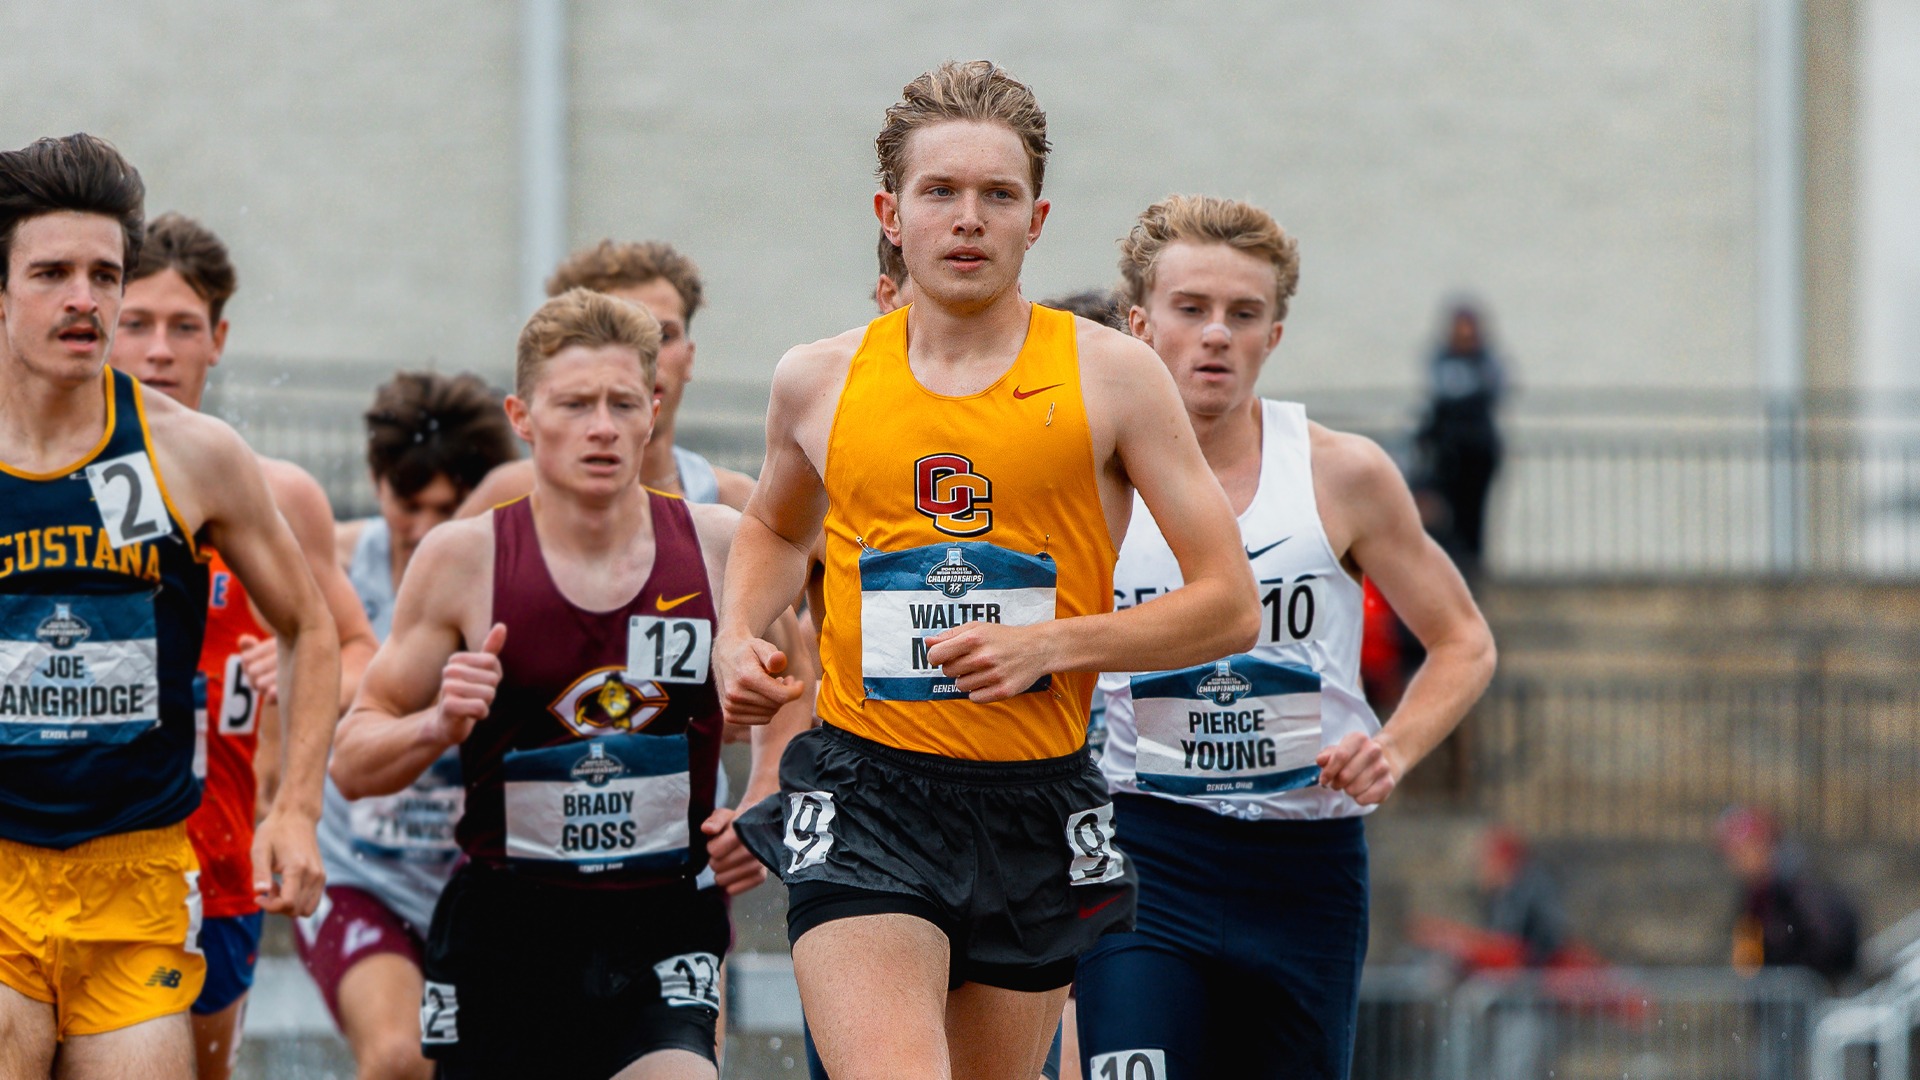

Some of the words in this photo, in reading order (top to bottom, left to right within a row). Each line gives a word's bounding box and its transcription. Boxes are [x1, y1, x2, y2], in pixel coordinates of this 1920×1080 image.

[101, 462, 159, 541] 2
[909, 603, 1001, 629] WALTER
[1261, 584, 1315, 641] 10
[644, 620, 697, 679] 12
[42, 655, 85, 679] JOE
[1188, 709, 1266, 734] PIERCE
[1180, 737, 1277, 771] YOUNG
[563, 791, 634, 817] BRADY
[561, 821, 637, 851] GOSS
